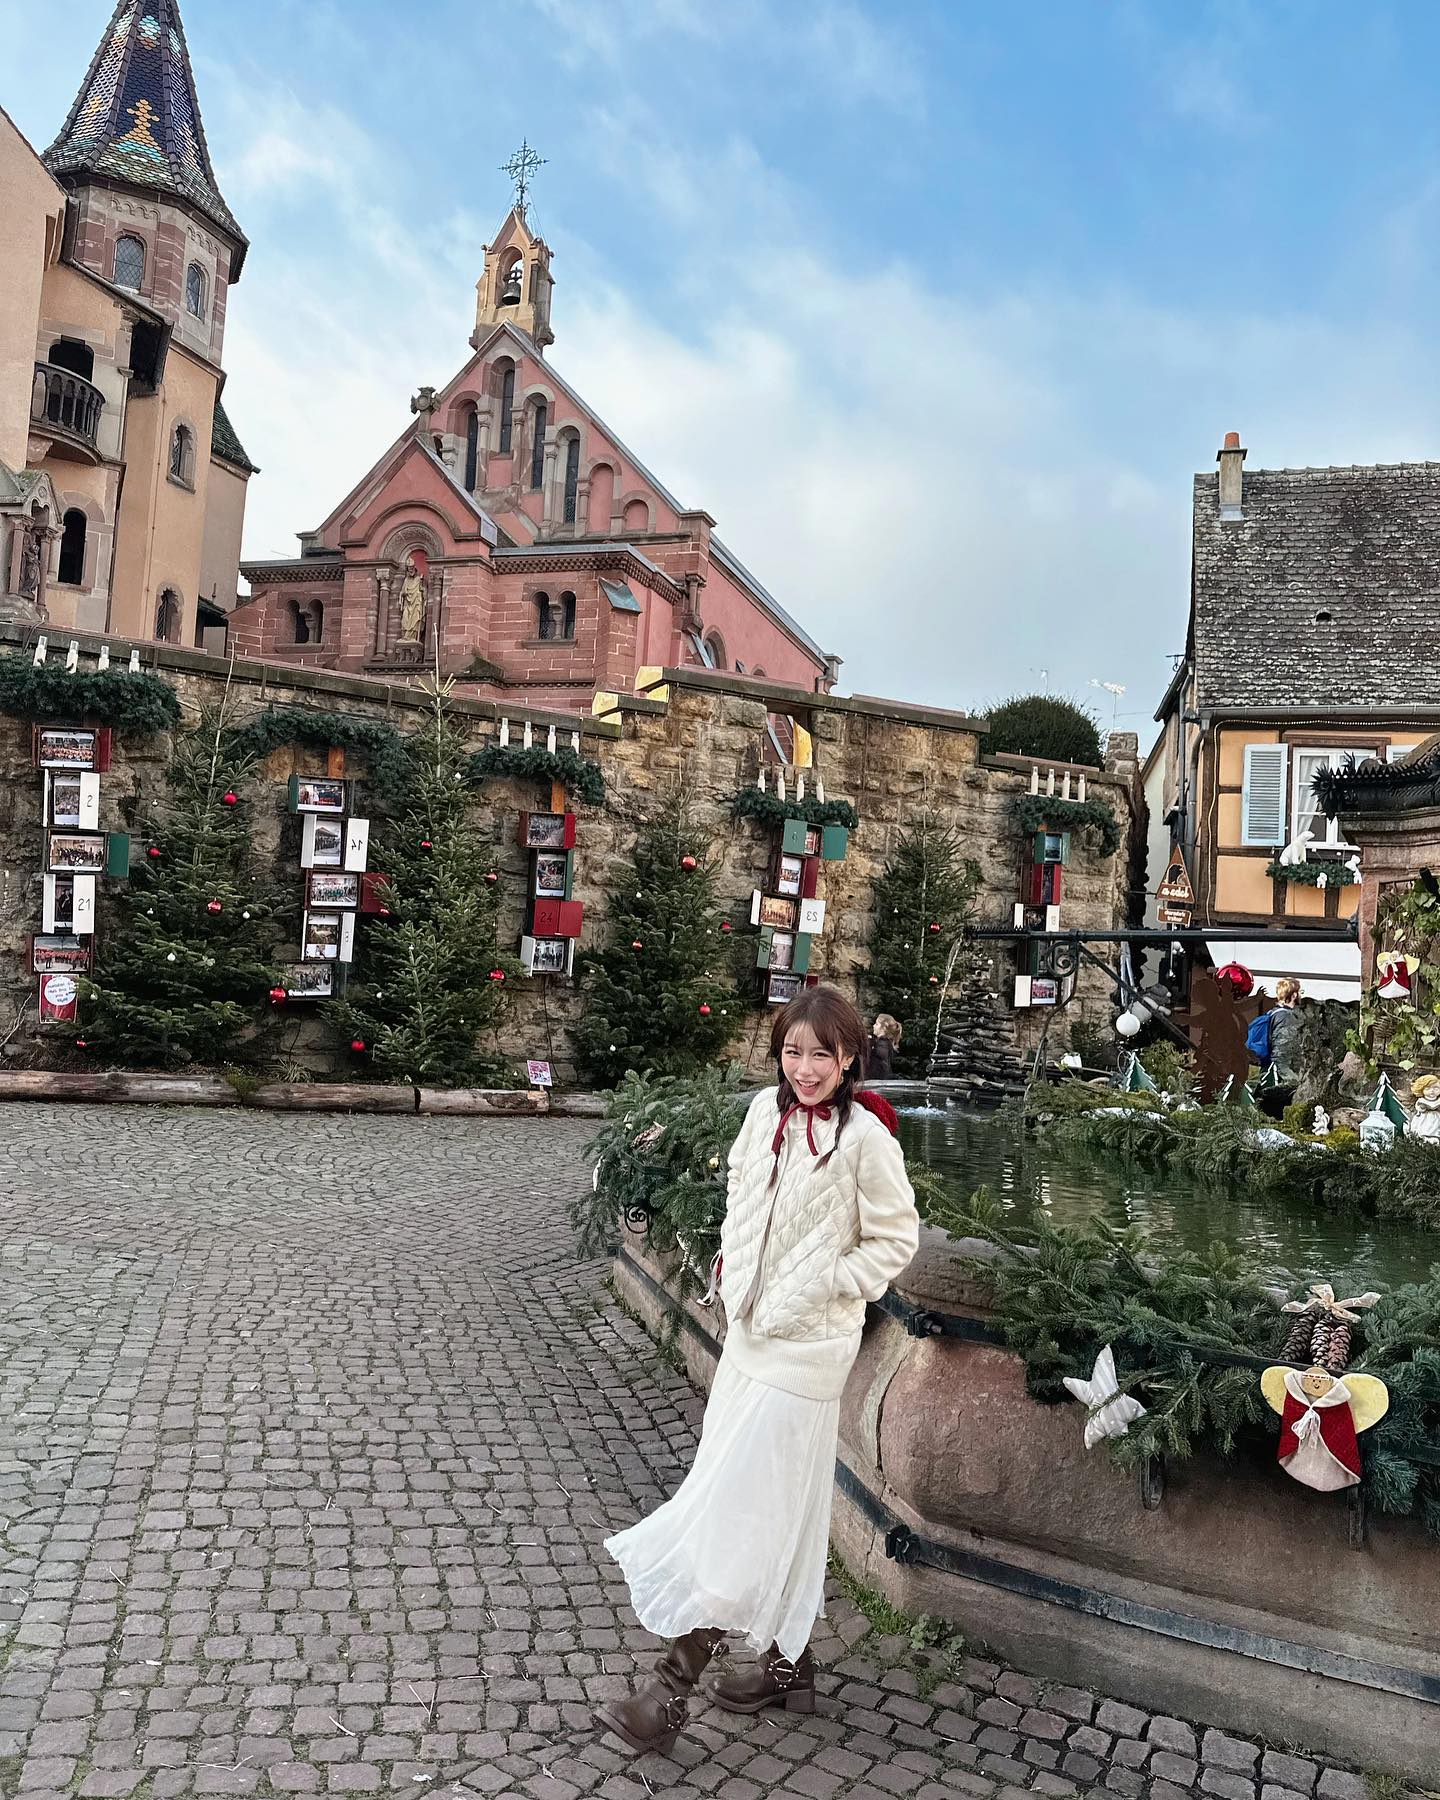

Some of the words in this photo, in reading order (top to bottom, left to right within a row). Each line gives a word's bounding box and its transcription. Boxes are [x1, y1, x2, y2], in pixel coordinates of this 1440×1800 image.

[86, 794, 93, 807] 2
[78, 897, 91, 911] 21
[539, 911, 553, 923] 24
